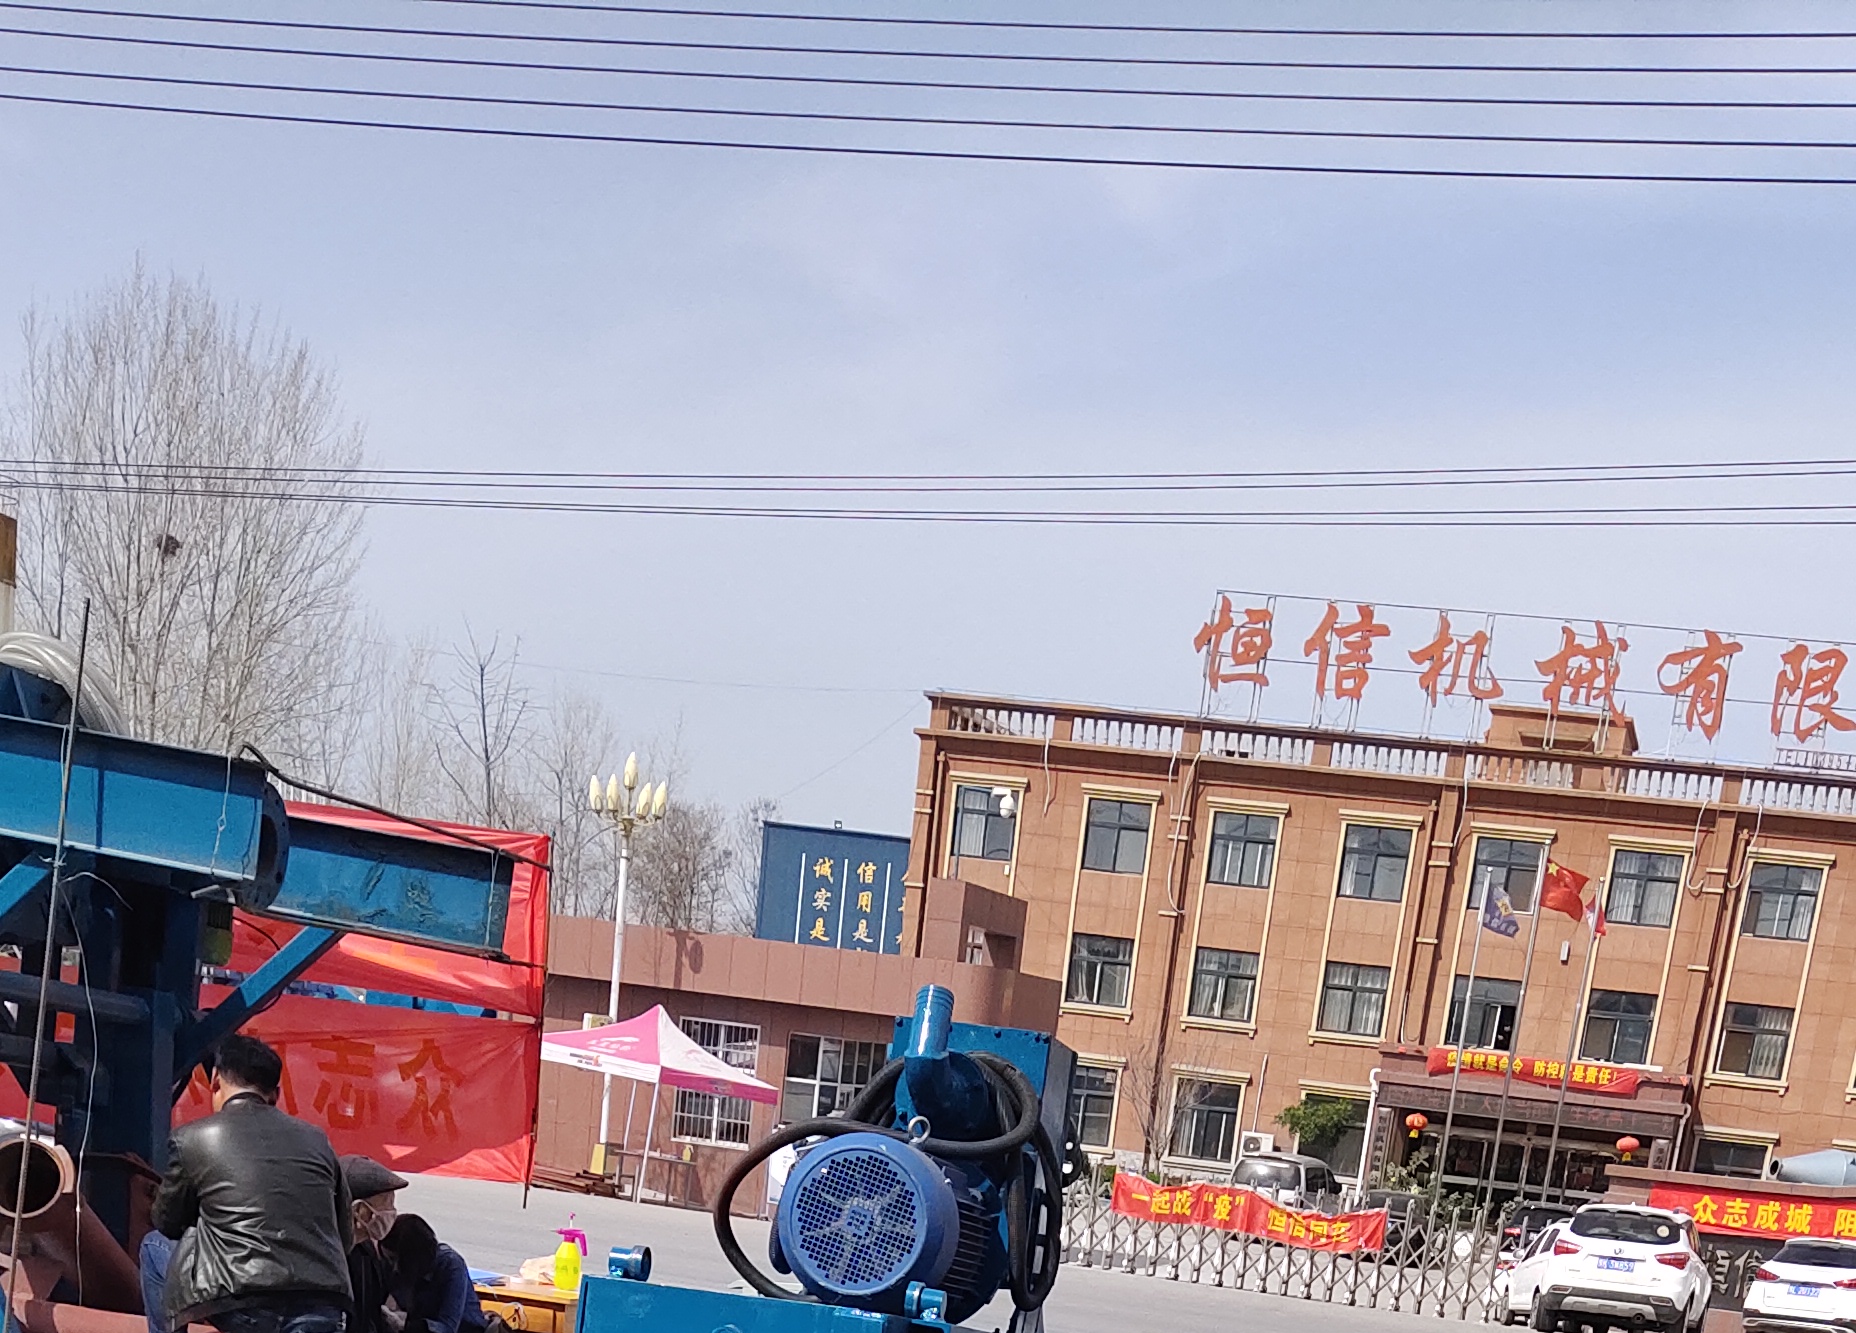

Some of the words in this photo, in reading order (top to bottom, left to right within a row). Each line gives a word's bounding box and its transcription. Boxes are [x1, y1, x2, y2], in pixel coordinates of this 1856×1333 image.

[1194, 595, 1856, 744] 恒信机械有限
[810, 857, 834, 942] 诚实是
[852, 861, 877, 953] 信用是
[1693, 1195, 1814, 1234] 众志成城
